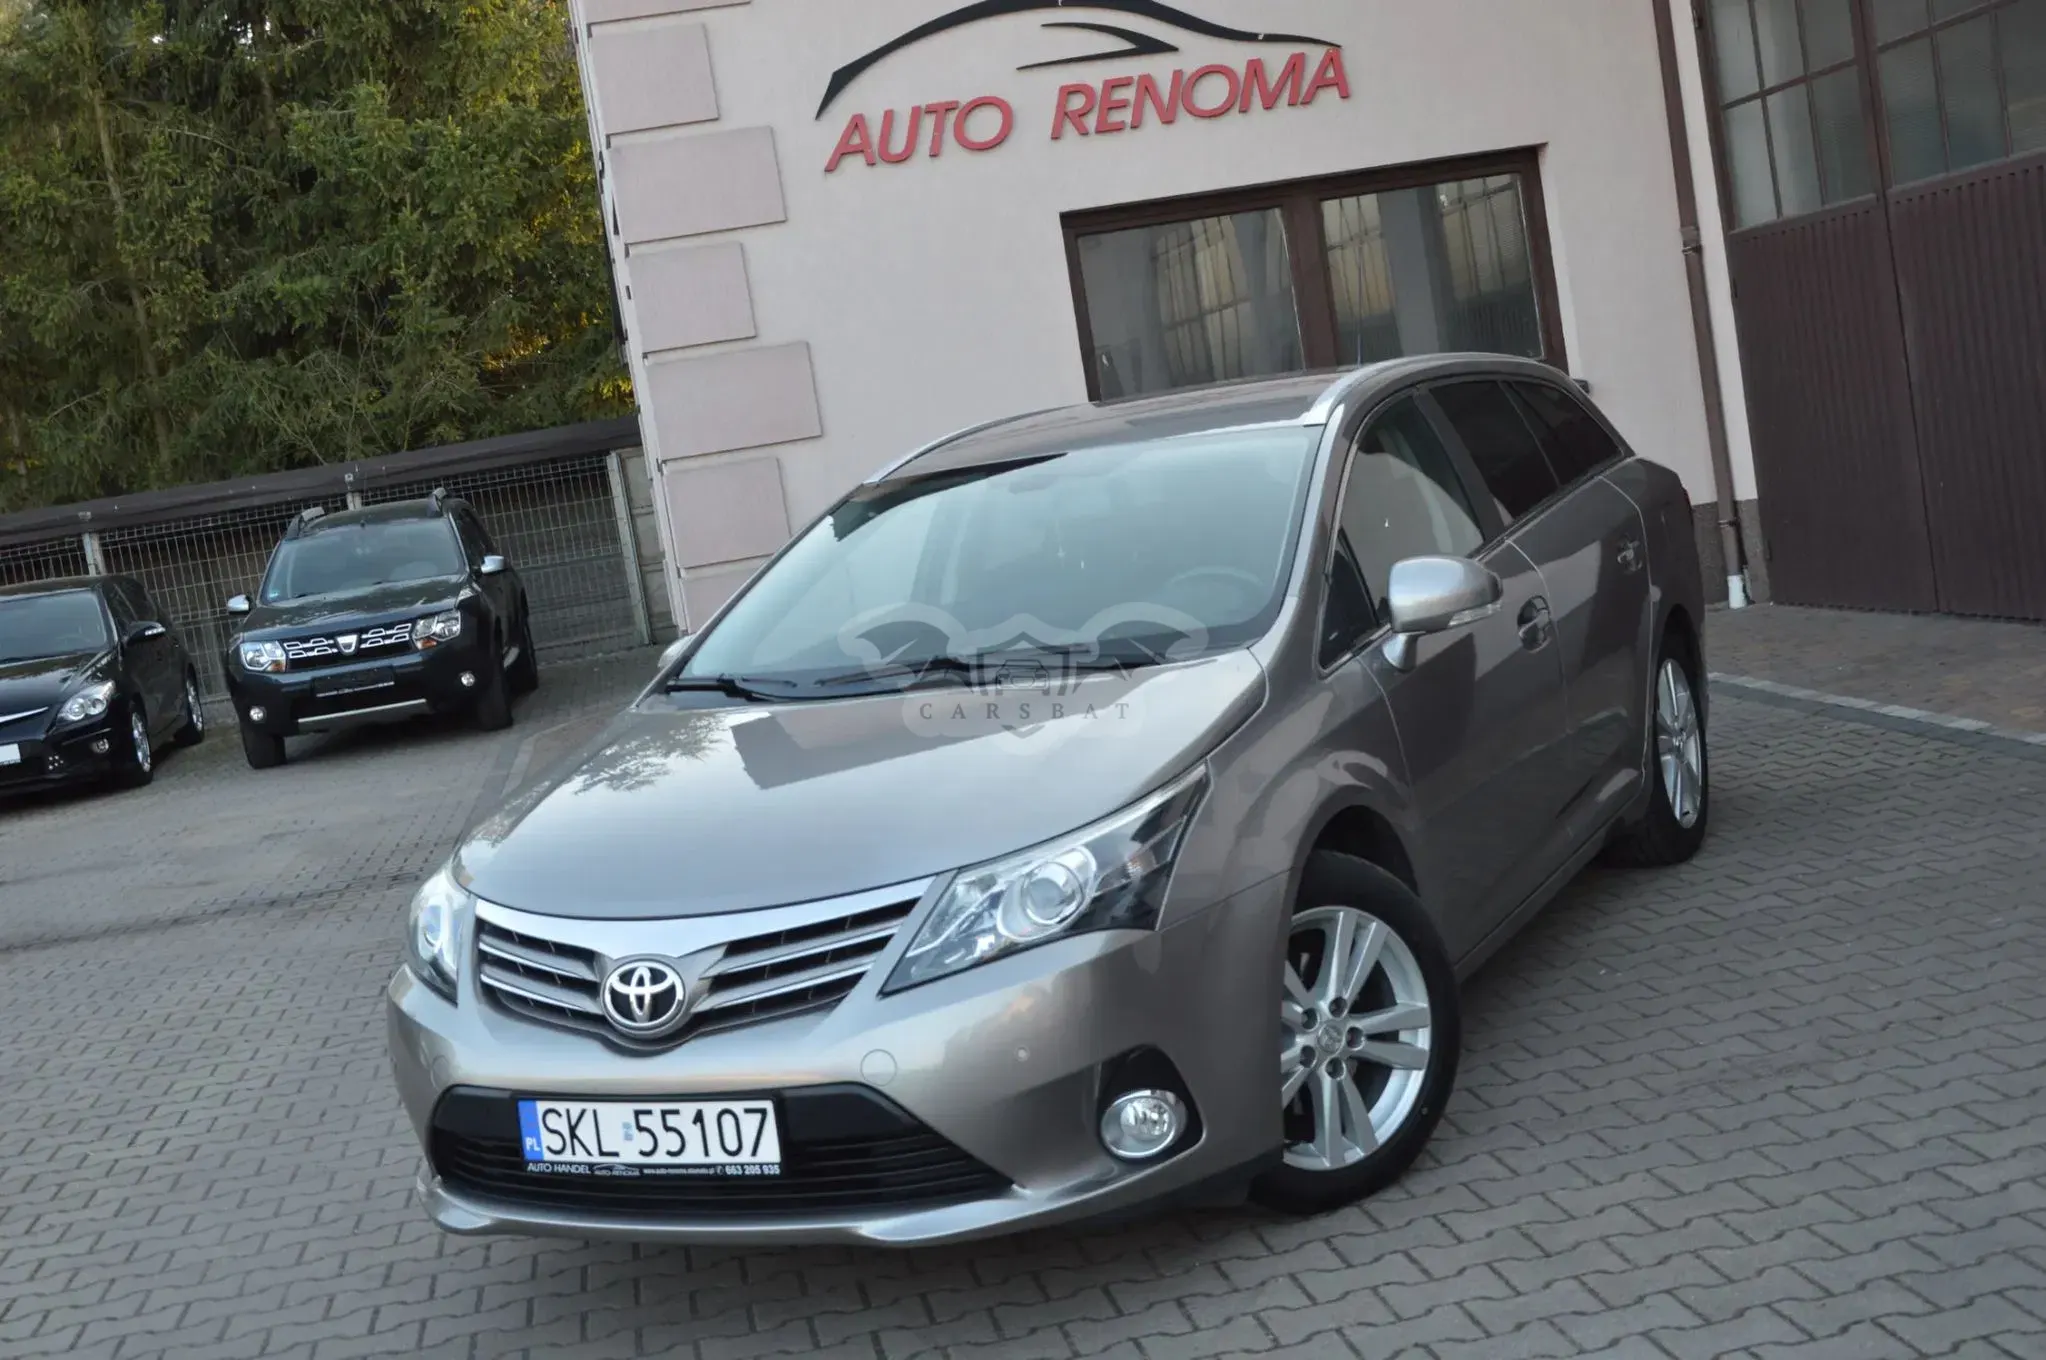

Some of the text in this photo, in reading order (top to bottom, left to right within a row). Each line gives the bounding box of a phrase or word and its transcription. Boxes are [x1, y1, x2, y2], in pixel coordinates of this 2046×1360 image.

[824, 48, 1351, 173] AUTO RENOMA
[525, 1137, 541, 1152] PL
[542, 1107, 768, 1158] SKL 55107
[527, 1162, 591, 1175] AUTO HANDEL
